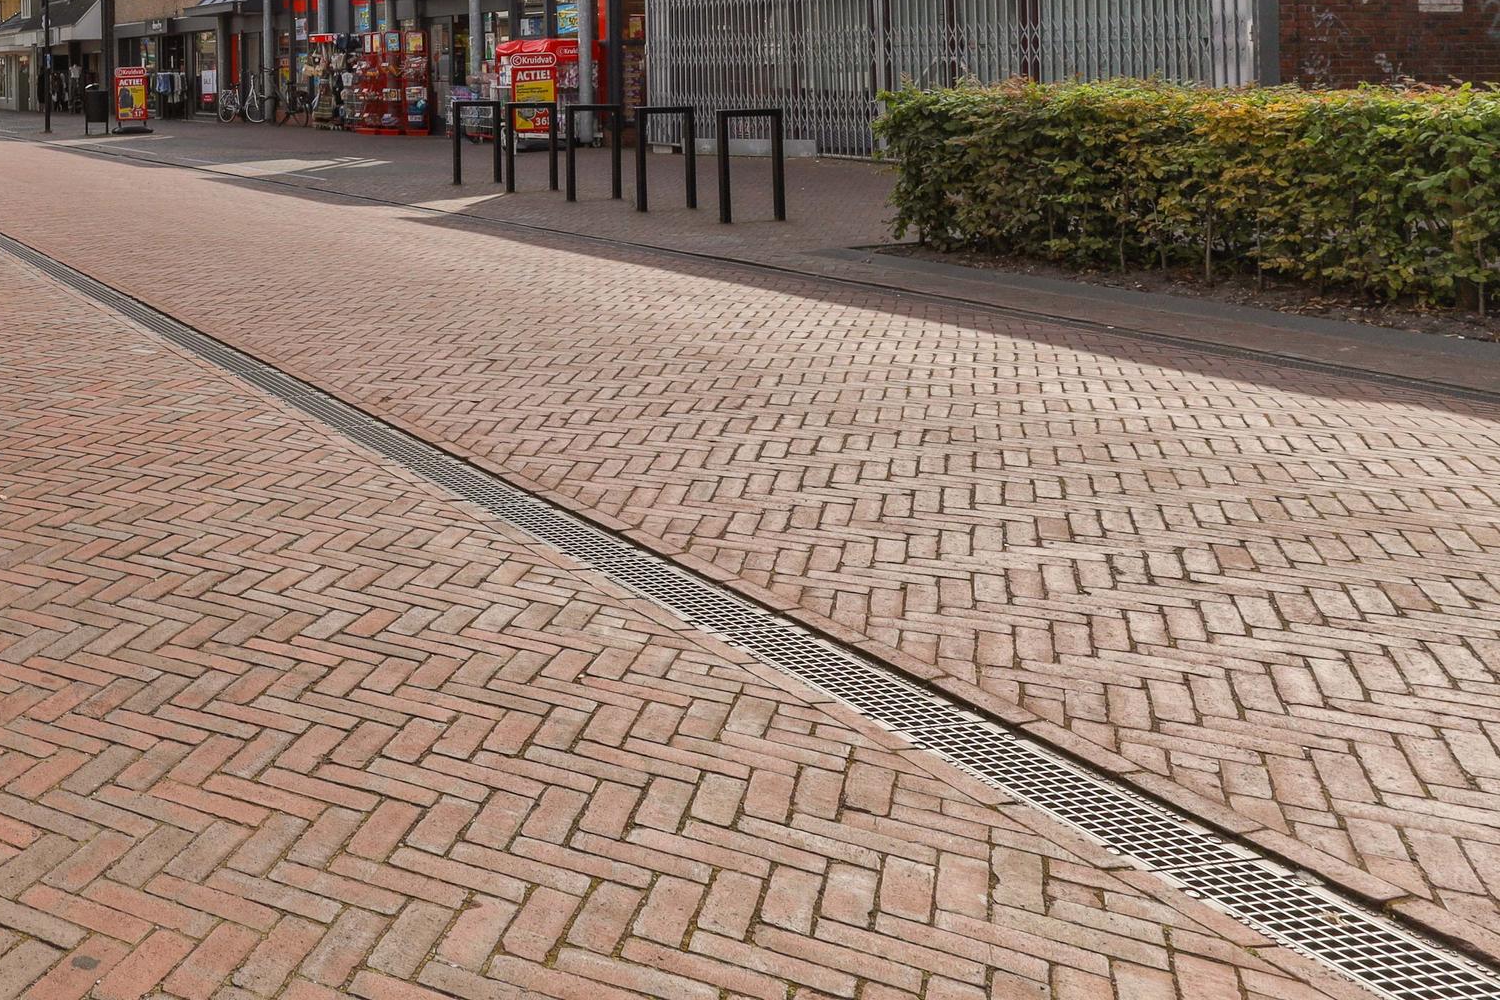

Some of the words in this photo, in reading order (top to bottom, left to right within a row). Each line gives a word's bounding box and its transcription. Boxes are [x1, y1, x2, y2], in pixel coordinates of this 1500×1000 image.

[521, 55, 553, 64] Kruidvat
[516, 69, 551, 81] ACTIE!
[118, 78, 143, 86] ACTIE!
